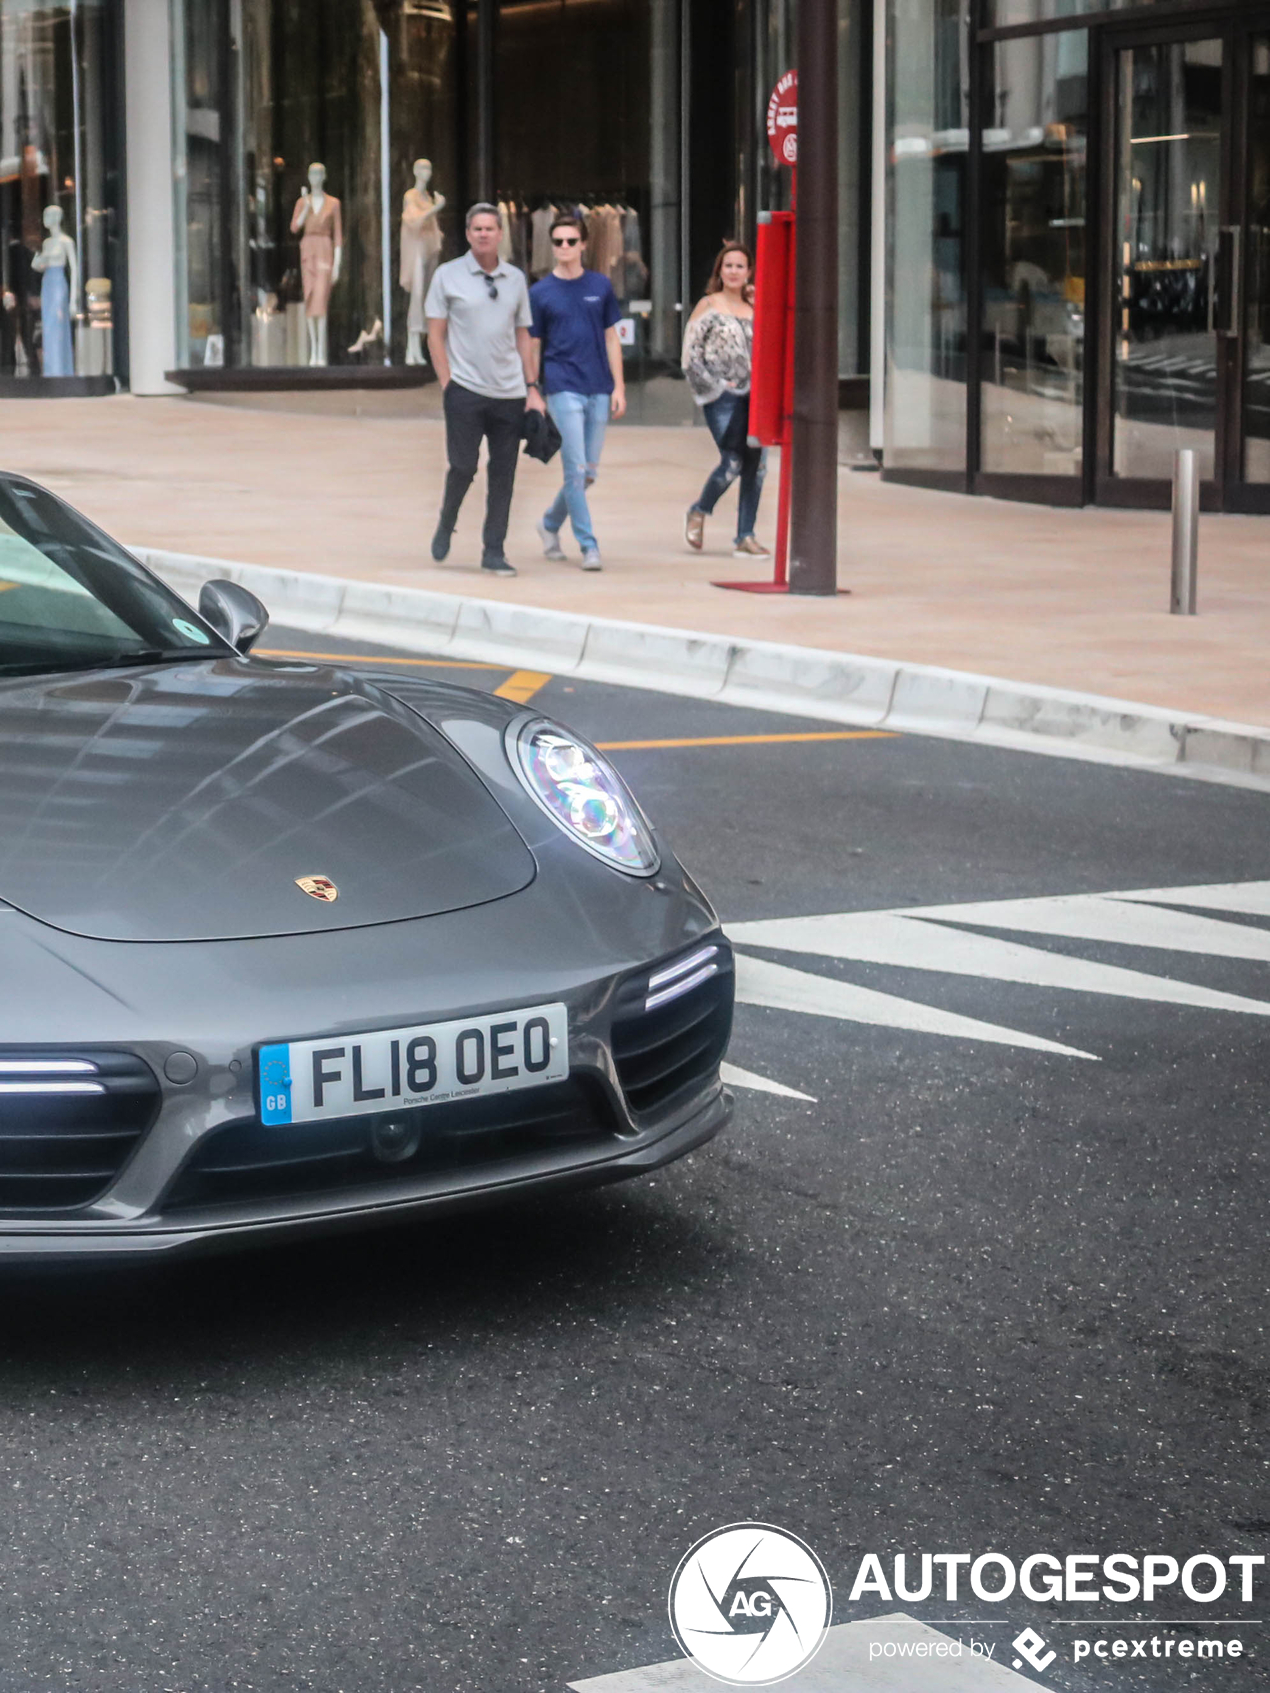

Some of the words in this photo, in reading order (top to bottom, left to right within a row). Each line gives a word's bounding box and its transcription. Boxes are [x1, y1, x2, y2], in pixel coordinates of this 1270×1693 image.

[313, 1036, 437, 1108] FL18
[456, 1017, 550, 1085] OEO
[266, 1094, 286, 1111] GB
[403, 1095, 428, 1105] Porsche
[430, 1091, 449, 1101] Centre
